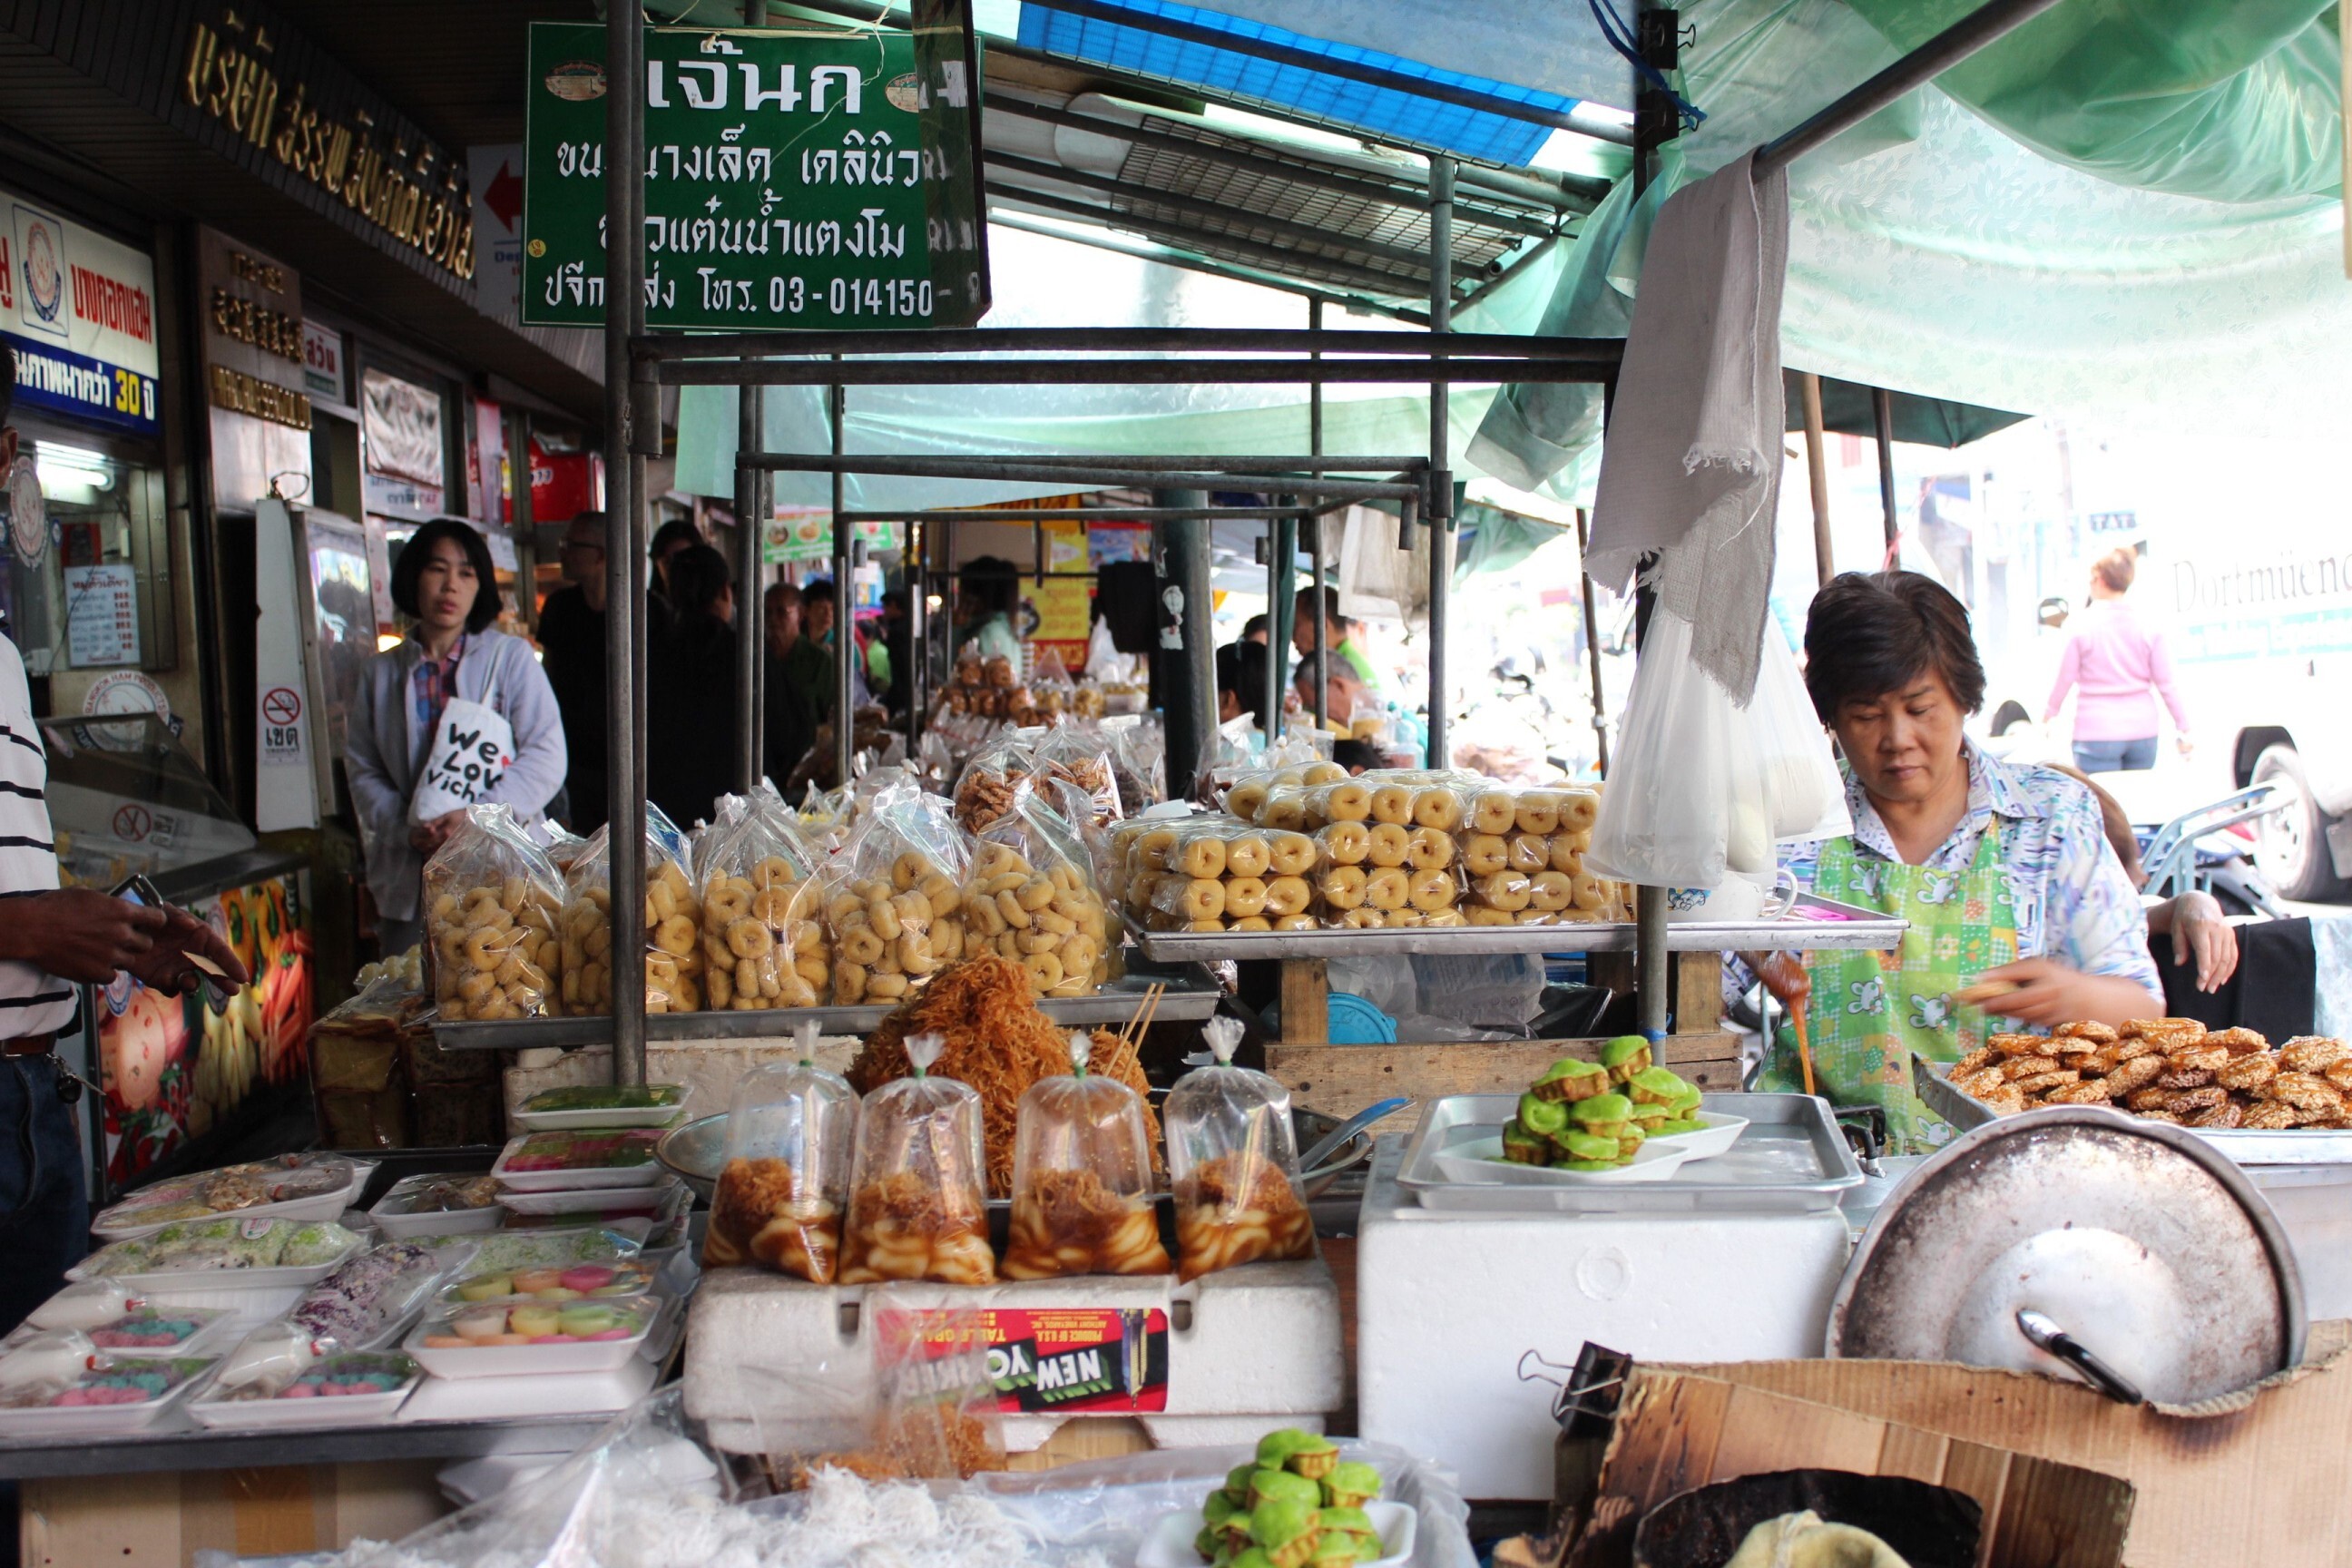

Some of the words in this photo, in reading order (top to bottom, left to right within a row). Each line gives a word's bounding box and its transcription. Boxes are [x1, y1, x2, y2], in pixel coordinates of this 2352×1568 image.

[115, 368, 141, 416] 30
[266, 727, 299, 747] เขต
[449, 723, 500, 764] We
[443, 751, 505, 791] Lov
[1037, 1348, 1102, 1392] NEW
